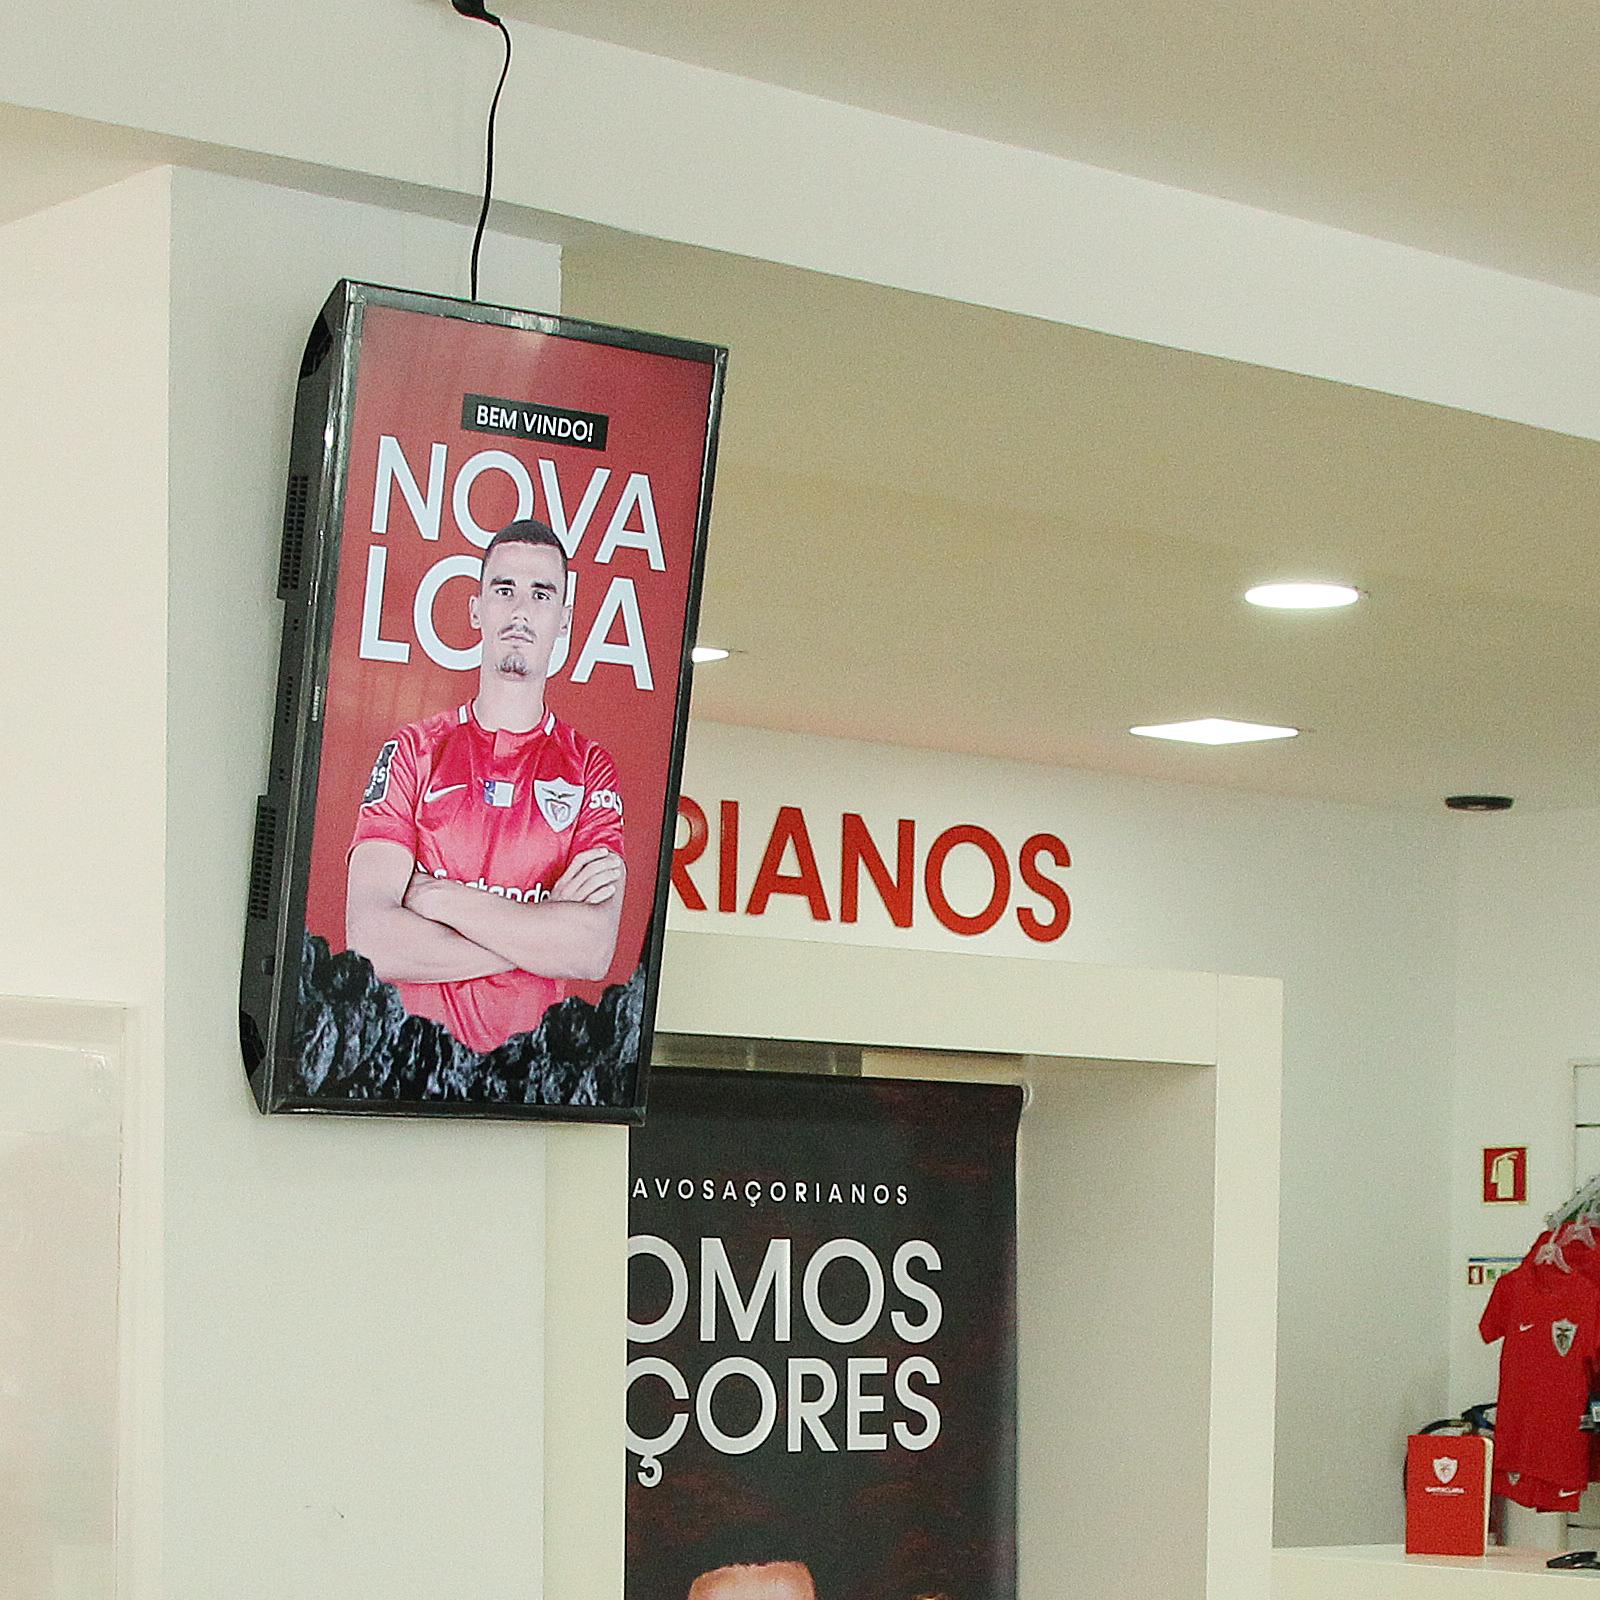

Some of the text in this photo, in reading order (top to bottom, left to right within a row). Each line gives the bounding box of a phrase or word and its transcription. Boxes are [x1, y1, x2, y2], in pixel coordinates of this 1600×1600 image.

[476, 404, 594, 442] BEM VINDO!
[371, 435, 666, 572] NOVA
[669, 795, 1072, 943] RIANOS
[632, 1177, 909, 1208] AVOSAÇORIANOS
[626, 1234, 944, 1344] OMOS
[625, 1355, 942, 1488] ÇORES
